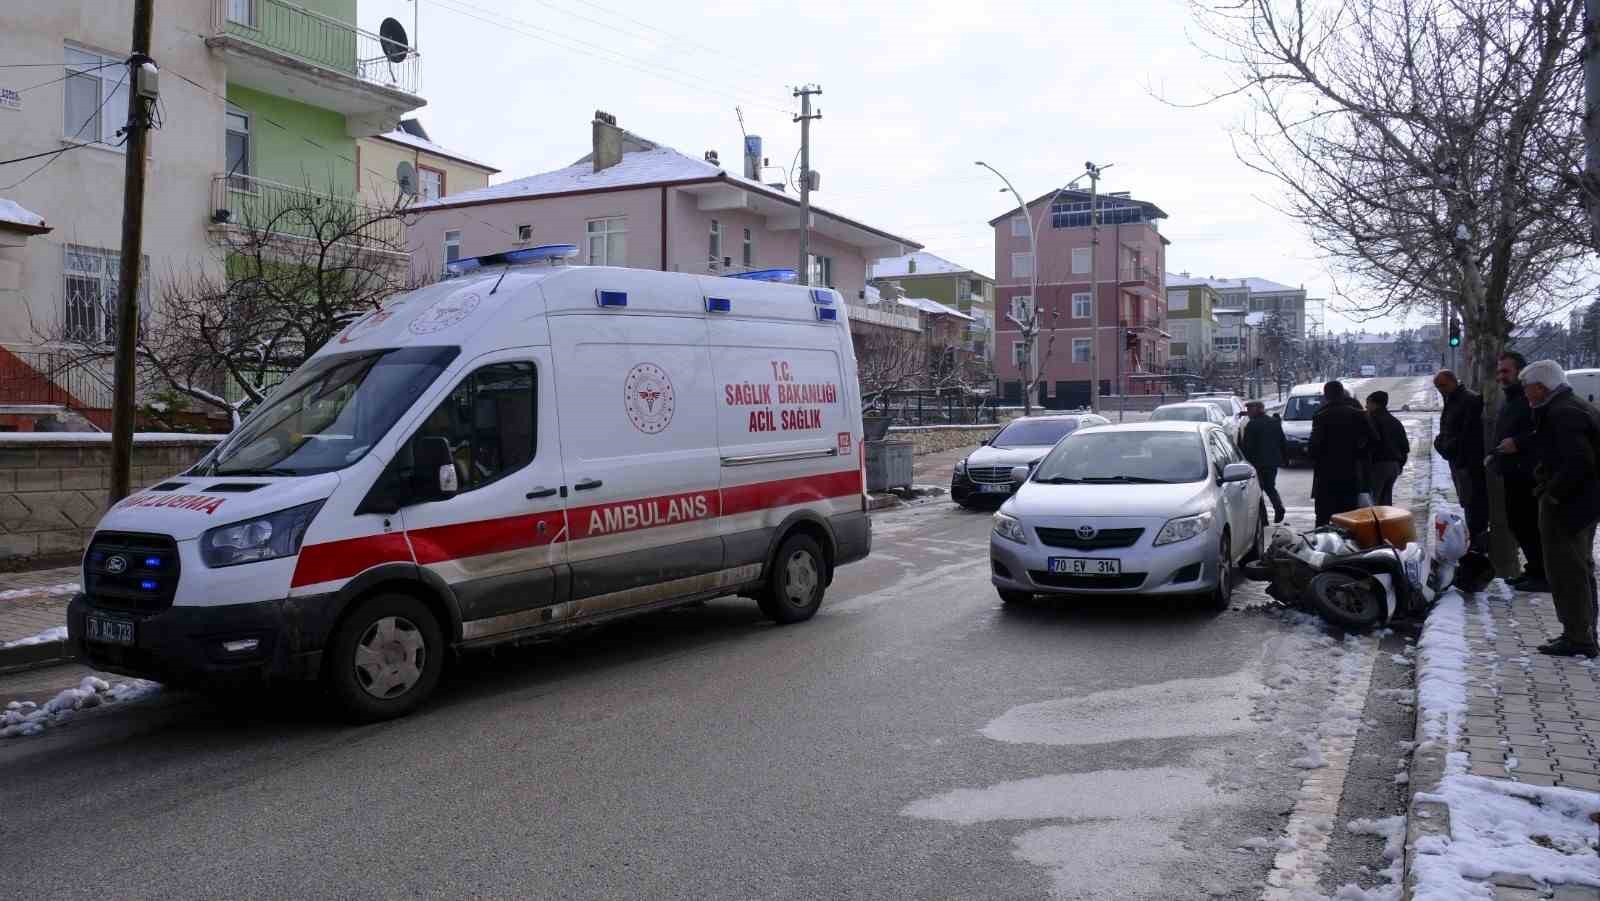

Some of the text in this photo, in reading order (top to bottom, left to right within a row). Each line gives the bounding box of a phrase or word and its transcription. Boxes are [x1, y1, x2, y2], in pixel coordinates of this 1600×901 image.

[771, 361, 794, 382] T.C.
[725, 380, 837, 406] SAĞLIK BAKANLIĞI
[749, 407, 821, 432] ACİL SAĞLIK
[588, 495, 708, 535] AMBULANS
[1055, 560, 1116, 572] 70 EV 314
